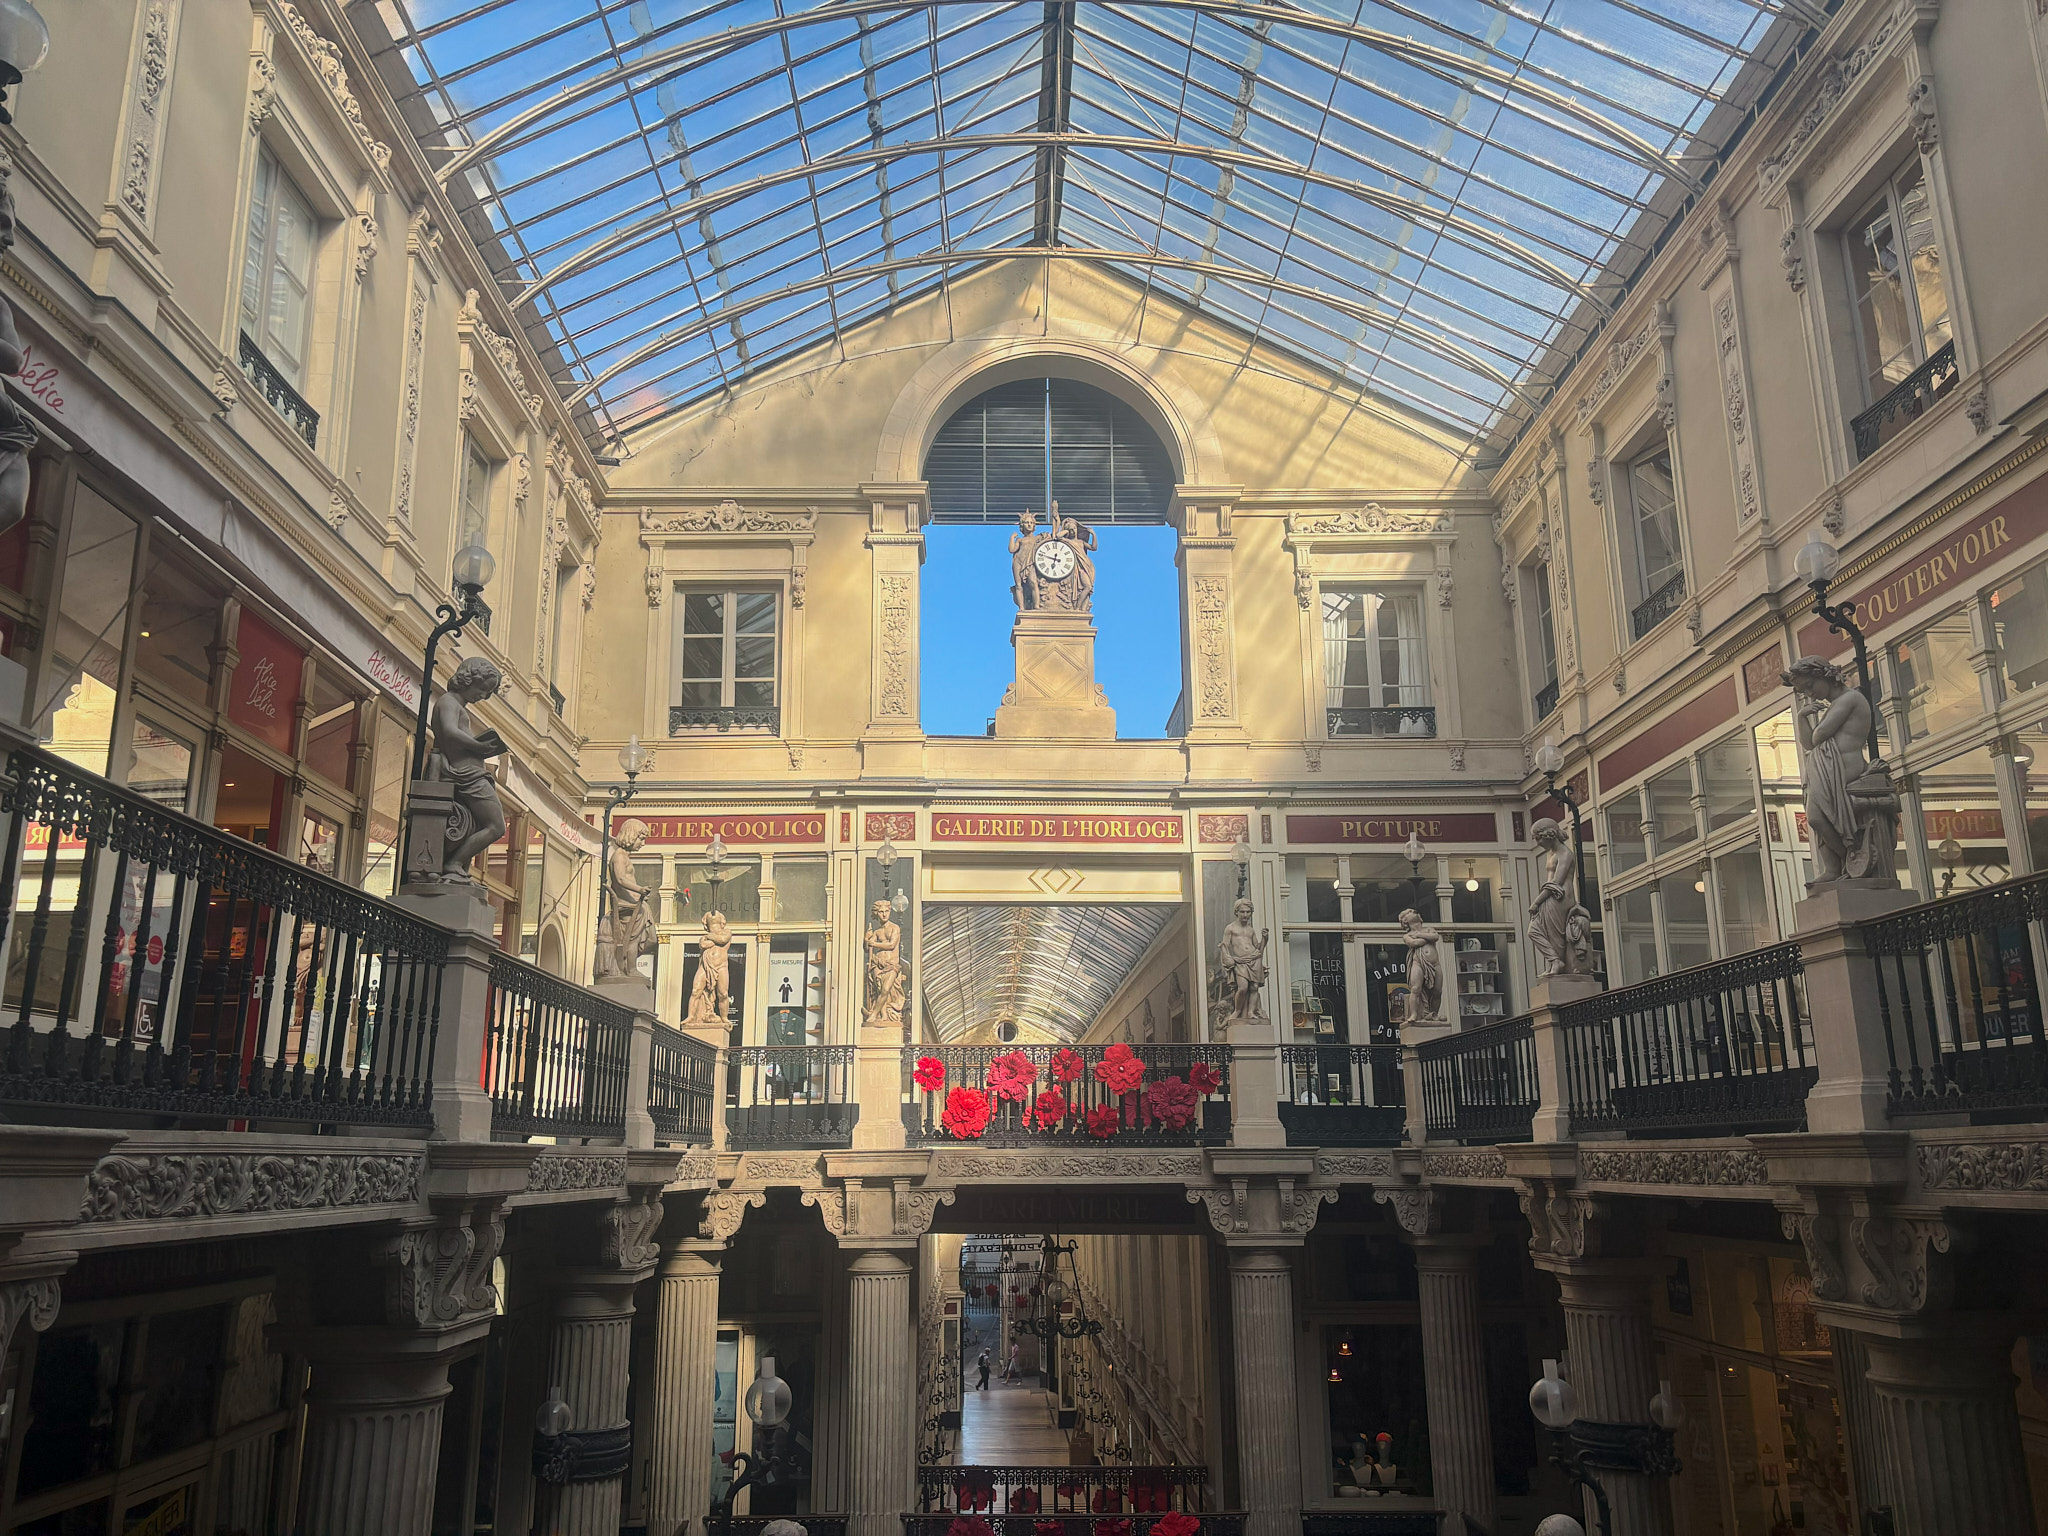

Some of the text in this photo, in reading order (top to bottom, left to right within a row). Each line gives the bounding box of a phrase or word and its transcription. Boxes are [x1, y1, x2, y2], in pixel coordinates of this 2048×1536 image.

[253, 656, 278, 691] Alice
[367, 649, 390, 686] Alice
[245, 681, 277, 719] Délice
[648, 820, 823, 840] ELIER COQLICO
[935, 818, 1180, 838] GALERIE DE L'HORLOGE
[1340, 820, 1443, 838] PICTURE
[1374, 963, 1406, 980] DADO
